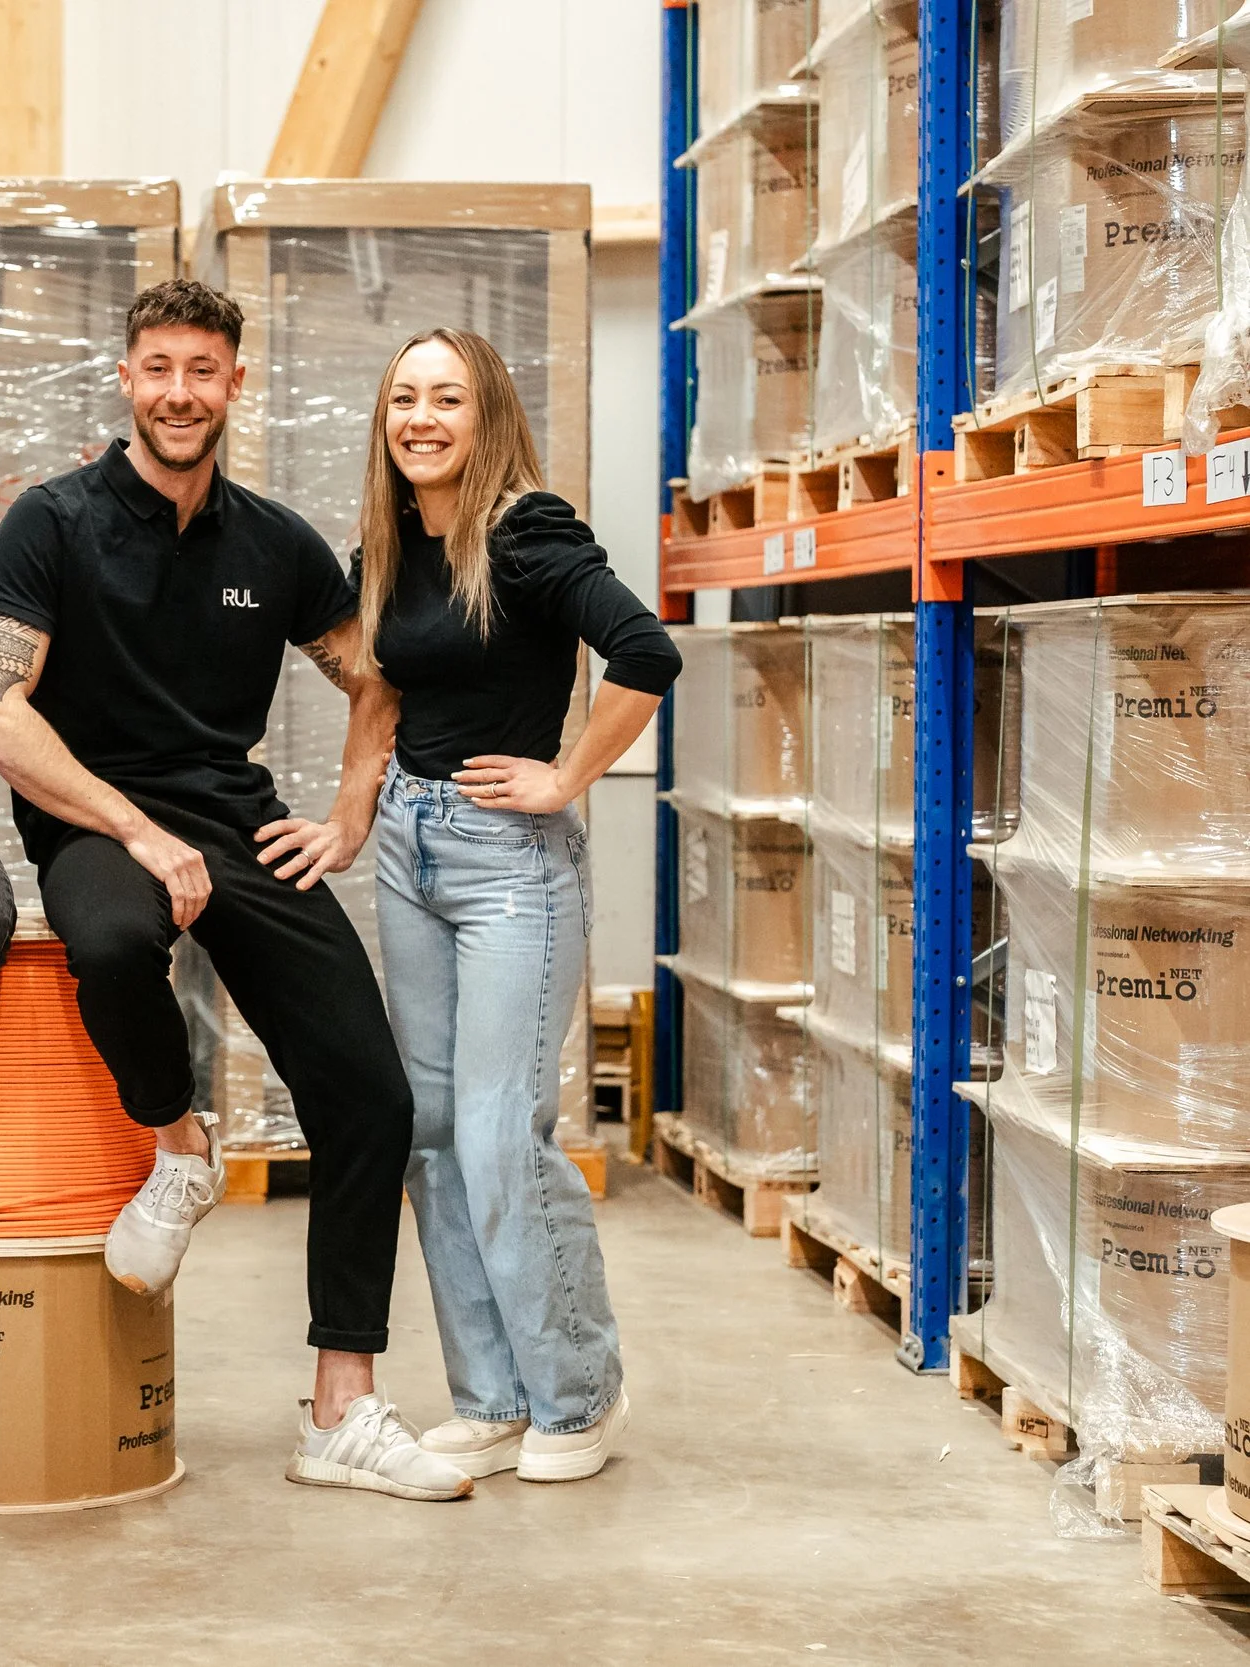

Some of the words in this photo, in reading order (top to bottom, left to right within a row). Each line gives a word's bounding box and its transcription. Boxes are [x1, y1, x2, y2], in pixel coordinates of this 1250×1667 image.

[222, 588, 260, 608] RUL
[1114, 690, 1217, 718] Premio
[1141, 926, 1235, 948] Networking
[1096, 969, 1197, 1001] Premio
[1170, 968, 1202, 980] NET
[1102, 1238, 1216, 1278] Premio
[1188, 1245, 1222, 1257] NET
